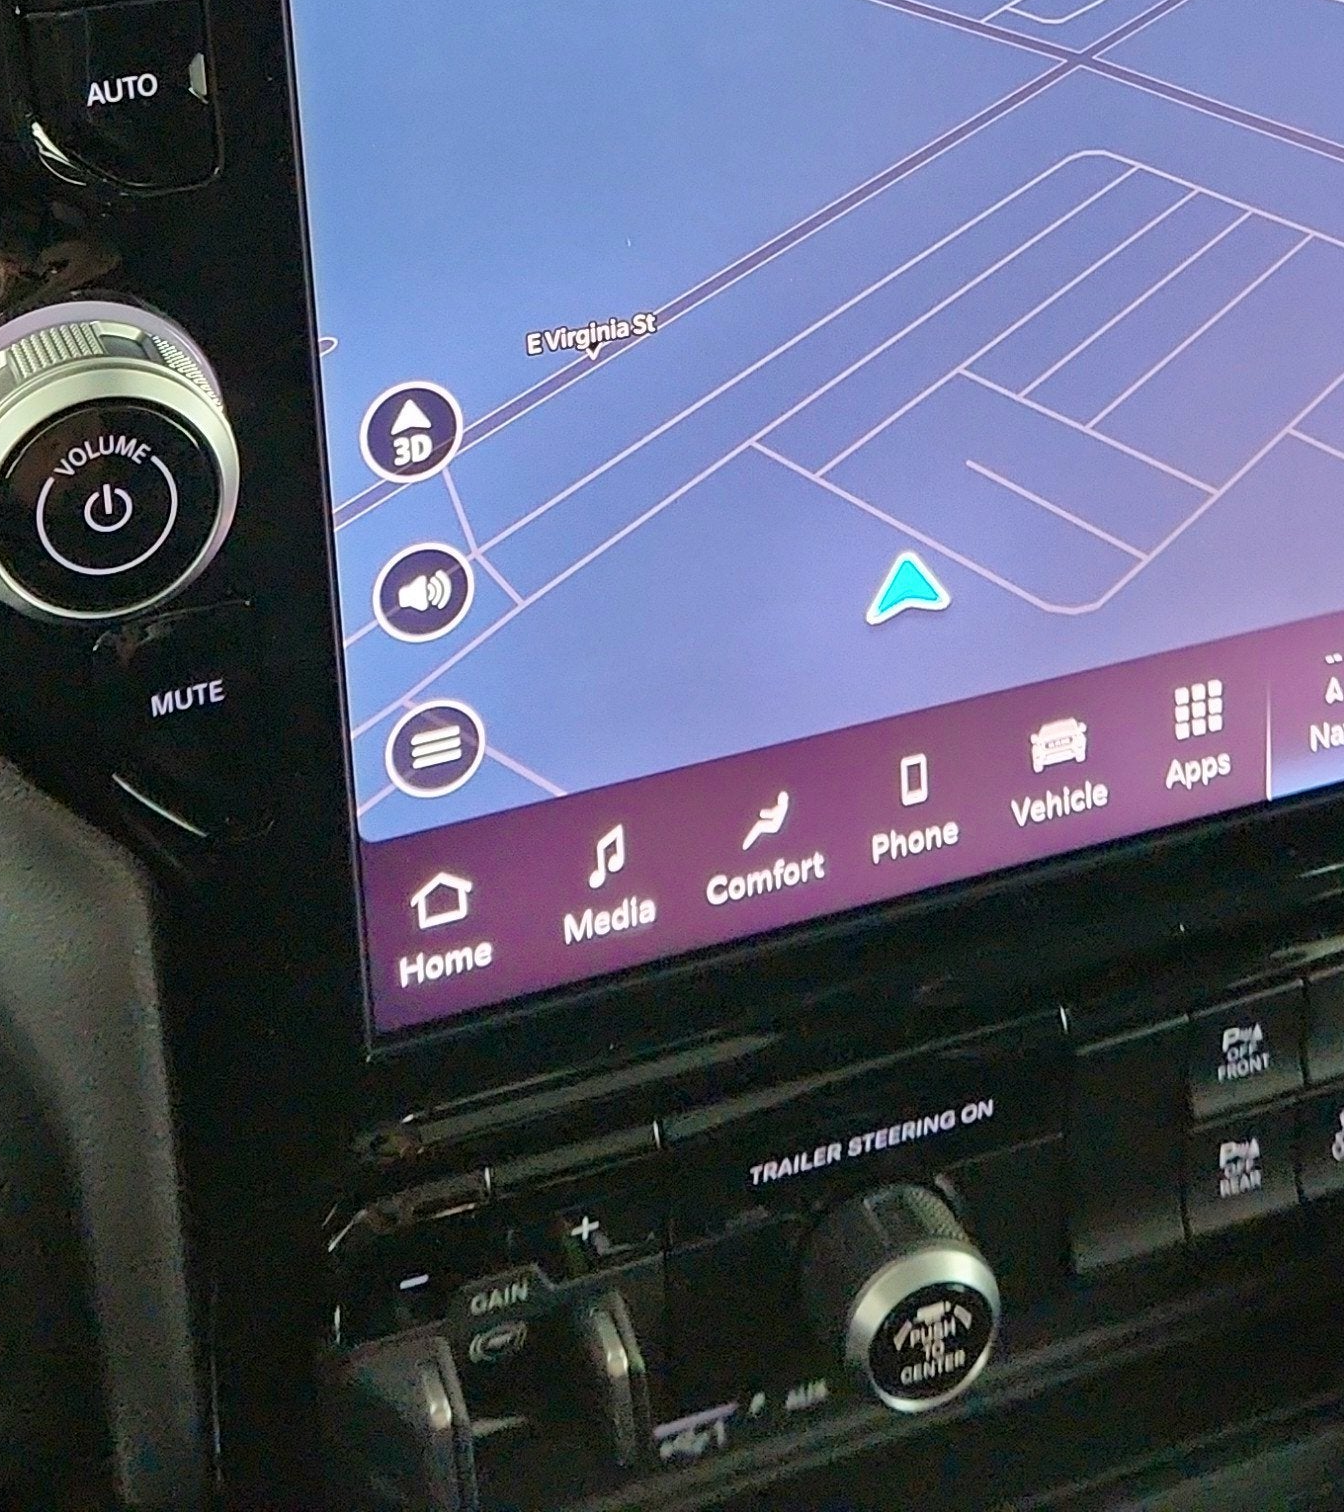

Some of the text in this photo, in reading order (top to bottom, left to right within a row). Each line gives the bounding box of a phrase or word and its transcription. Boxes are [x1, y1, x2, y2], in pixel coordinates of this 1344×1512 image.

[86, 72, 158, 106] AUTO
[527, 312, 656, 356] E Virginia St
[53, 434, 153, 479] VOLUME
[393, 434, 433, 466] 3D
[150, 678, 226, 718] MUTE
[399, 941, 493, 989] Home
[563, 895, 657, 945] Media
[706, 851, 825, 906] Comfort
[871, 821, 959, 865] Phone
[1010, 780, 1109, 827] Vehicle
[1165, 752, 1232, 790] Apps
[749, 1098, 994, 1186] TRAILER STEERING ON
